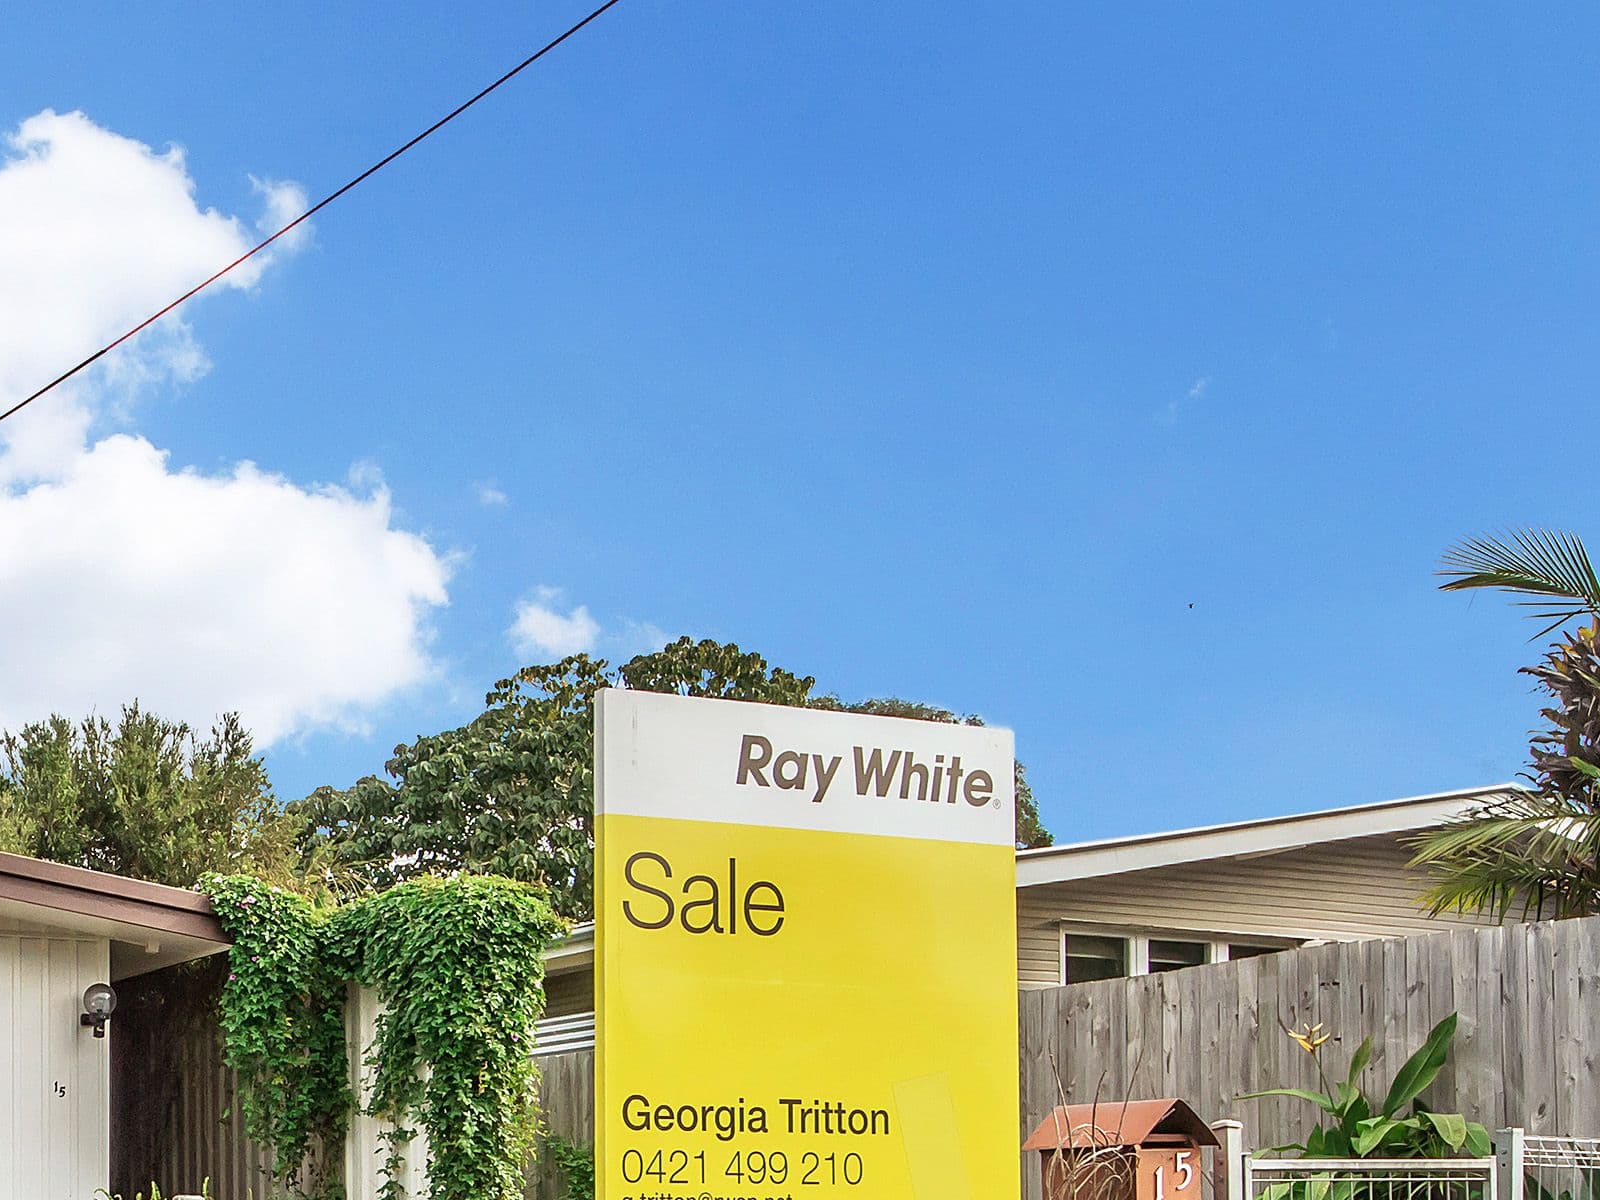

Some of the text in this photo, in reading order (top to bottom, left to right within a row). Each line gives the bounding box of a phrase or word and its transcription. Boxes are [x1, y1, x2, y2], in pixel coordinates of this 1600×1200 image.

[736, 734, 994, 807] Ray White
[622, 852, 785, 936] Sale
[54, 1081, 66, 1098] 15
[622, 1094, 890, 1142] Georgia Tritton
[622, 1150, 863, 1185] 0421 499 210
